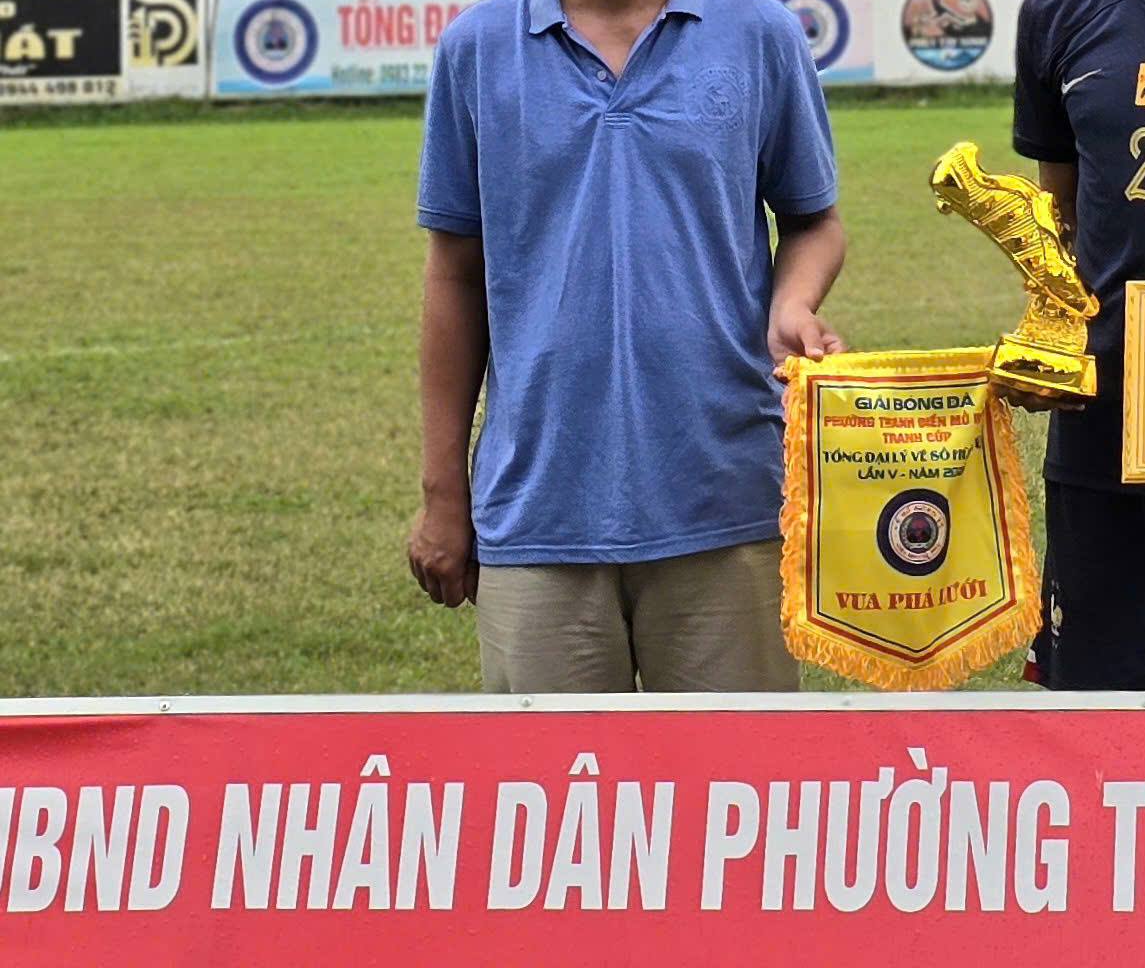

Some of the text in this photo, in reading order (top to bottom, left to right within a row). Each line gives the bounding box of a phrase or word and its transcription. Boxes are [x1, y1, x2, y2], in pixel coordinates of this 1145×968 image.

[888, 469, 899, 479] V
[836, 591, 883, 611] VUA
[888, 587, 935, 610] PHÁ
[211, 753, 465, 911] NHÂN
[487, 752, 675, 911] DÂN
[700, 747, 1071, 913] PHƯỜNG
